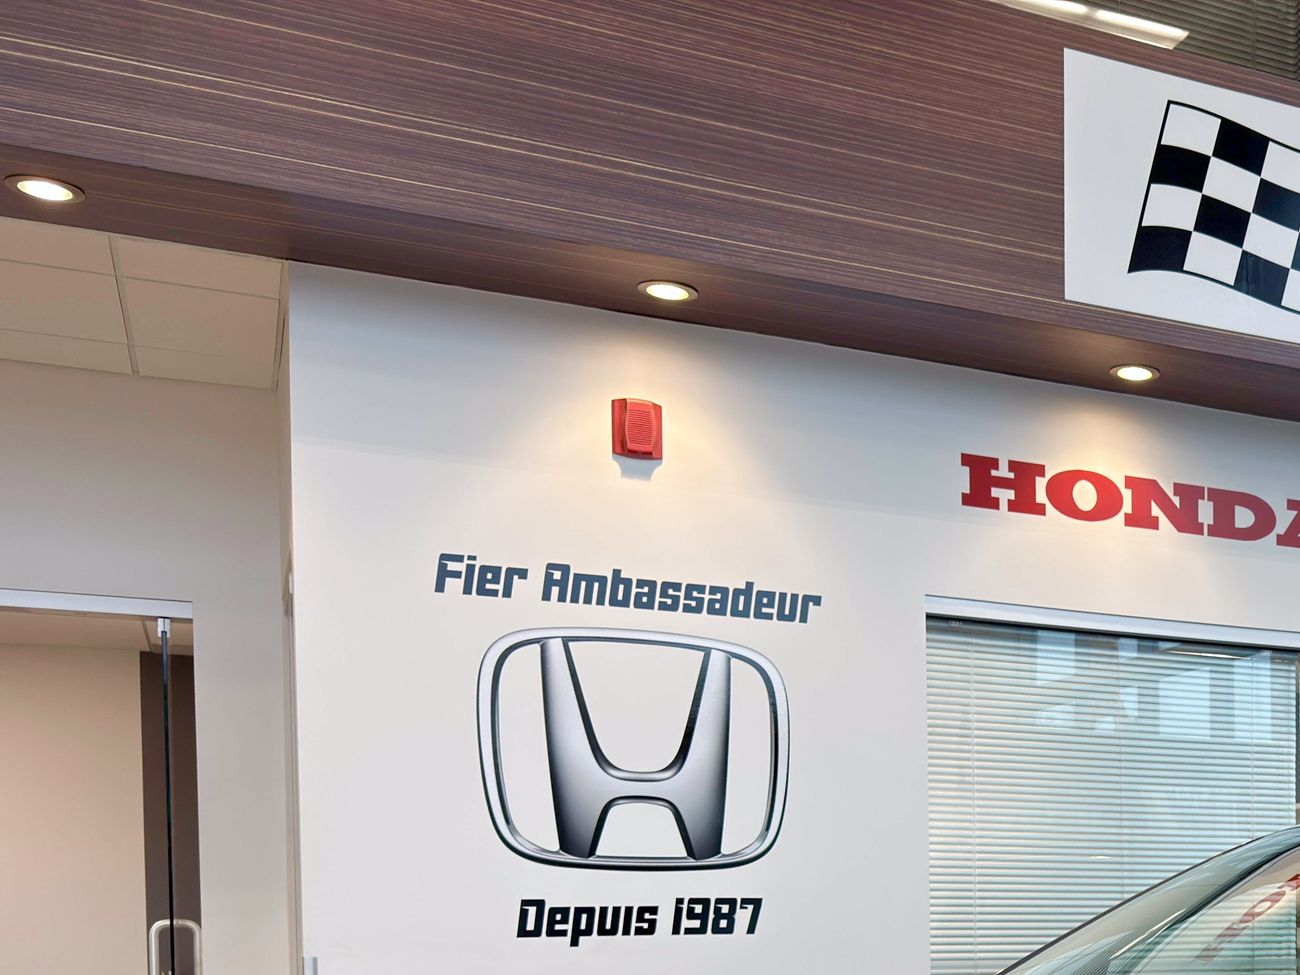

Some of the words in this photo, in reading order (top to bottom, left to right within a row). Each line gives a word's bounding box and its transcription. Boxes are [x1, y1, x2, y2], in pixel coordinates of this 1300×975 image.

[434, 553, 529, 599] Fier
[541, 562, 823, 624] Ambassadeur
[516, 898, 659, 948] Depuis
